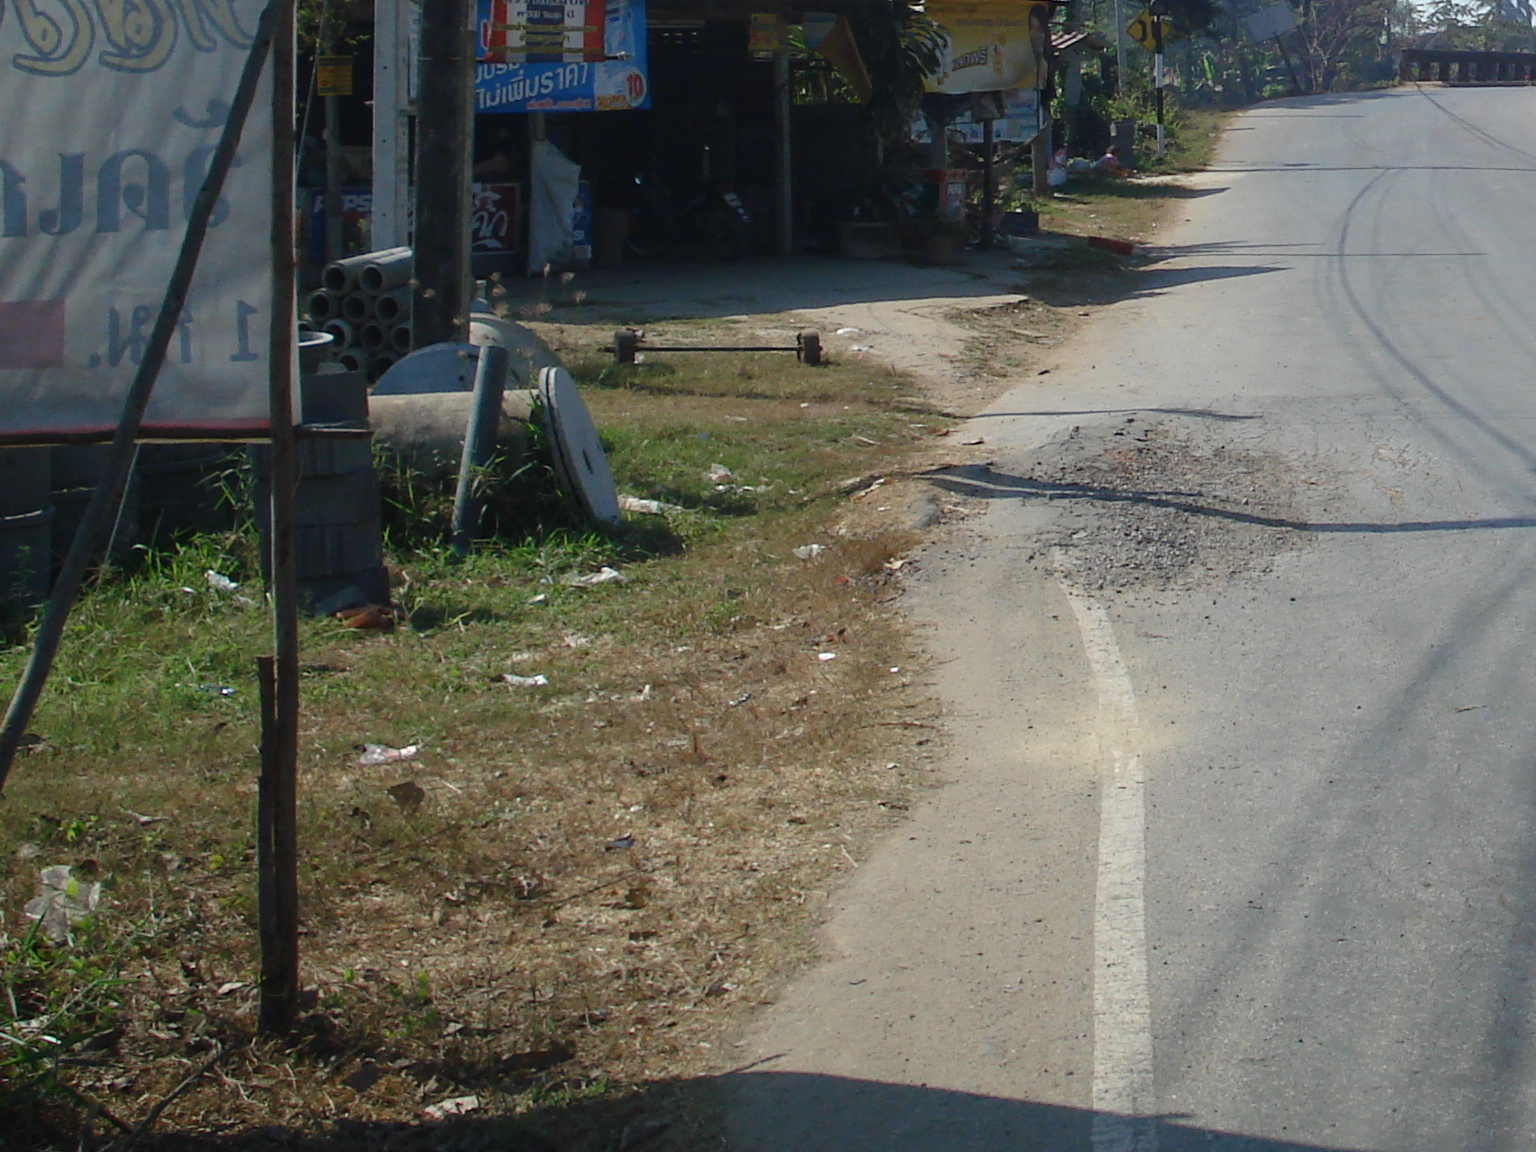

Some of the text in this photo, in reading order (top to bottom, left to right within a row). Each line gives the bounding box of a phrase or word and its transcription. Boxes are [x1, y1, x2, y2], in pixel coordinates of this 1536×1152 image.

[476, 63, 589, 108] ไม่เพิ่มราคา
